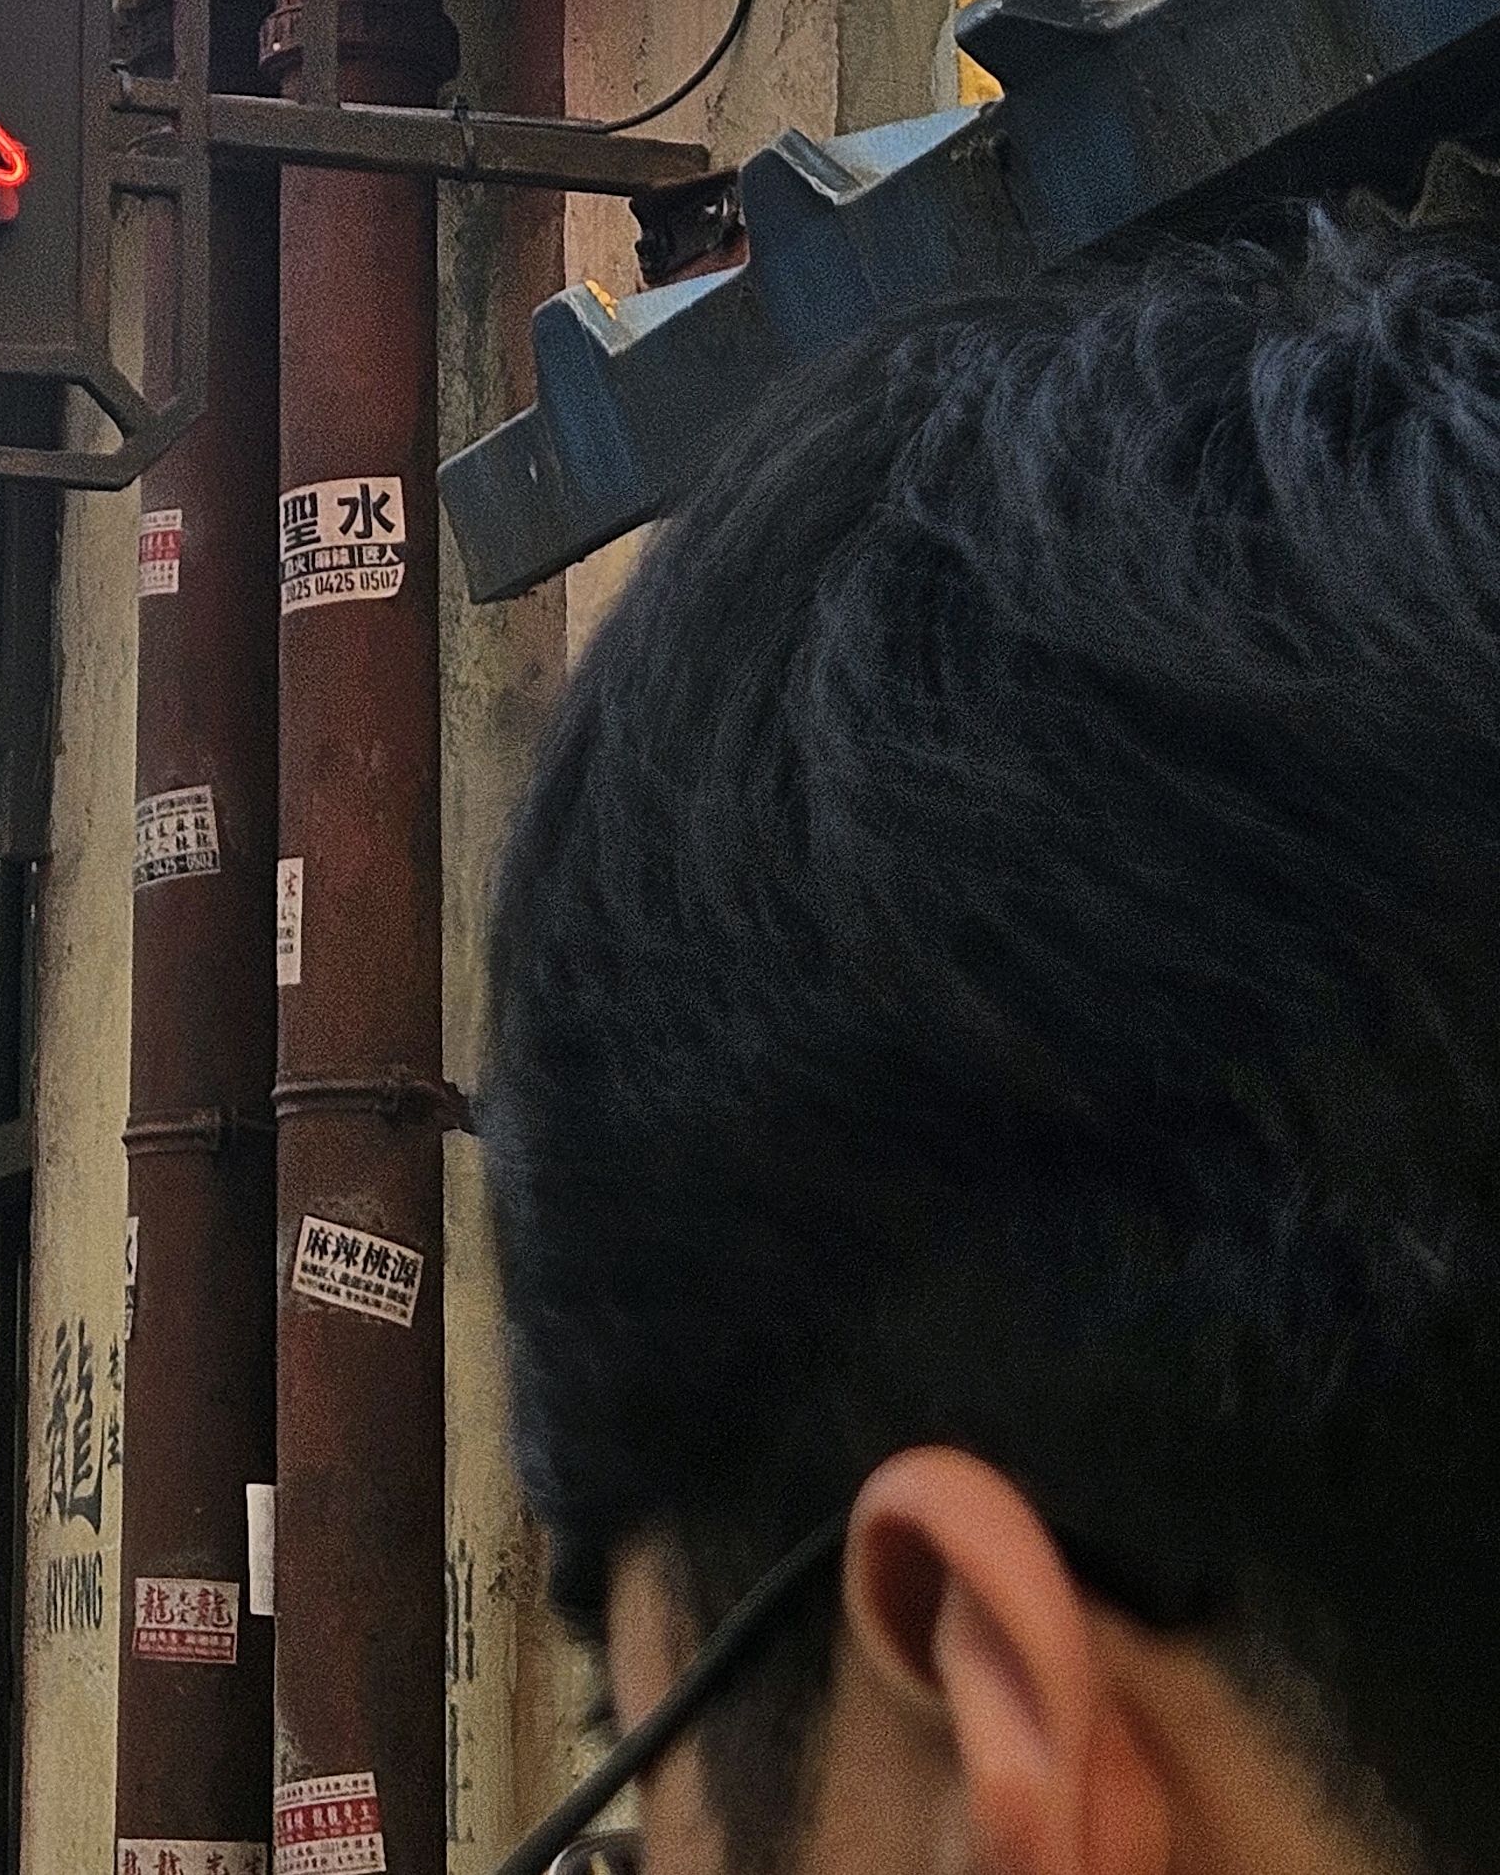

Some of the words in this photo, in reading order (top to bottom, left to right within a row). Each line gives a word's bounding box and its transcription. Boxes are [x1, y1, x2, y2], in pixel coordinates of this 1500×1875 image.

[283, 482, 396, 554] 聖水
[314, 571, 355, 595] 0425
[359, 568, 399, 592] 0502
[303, 1225, 419, 1289] 麻辣桃源
